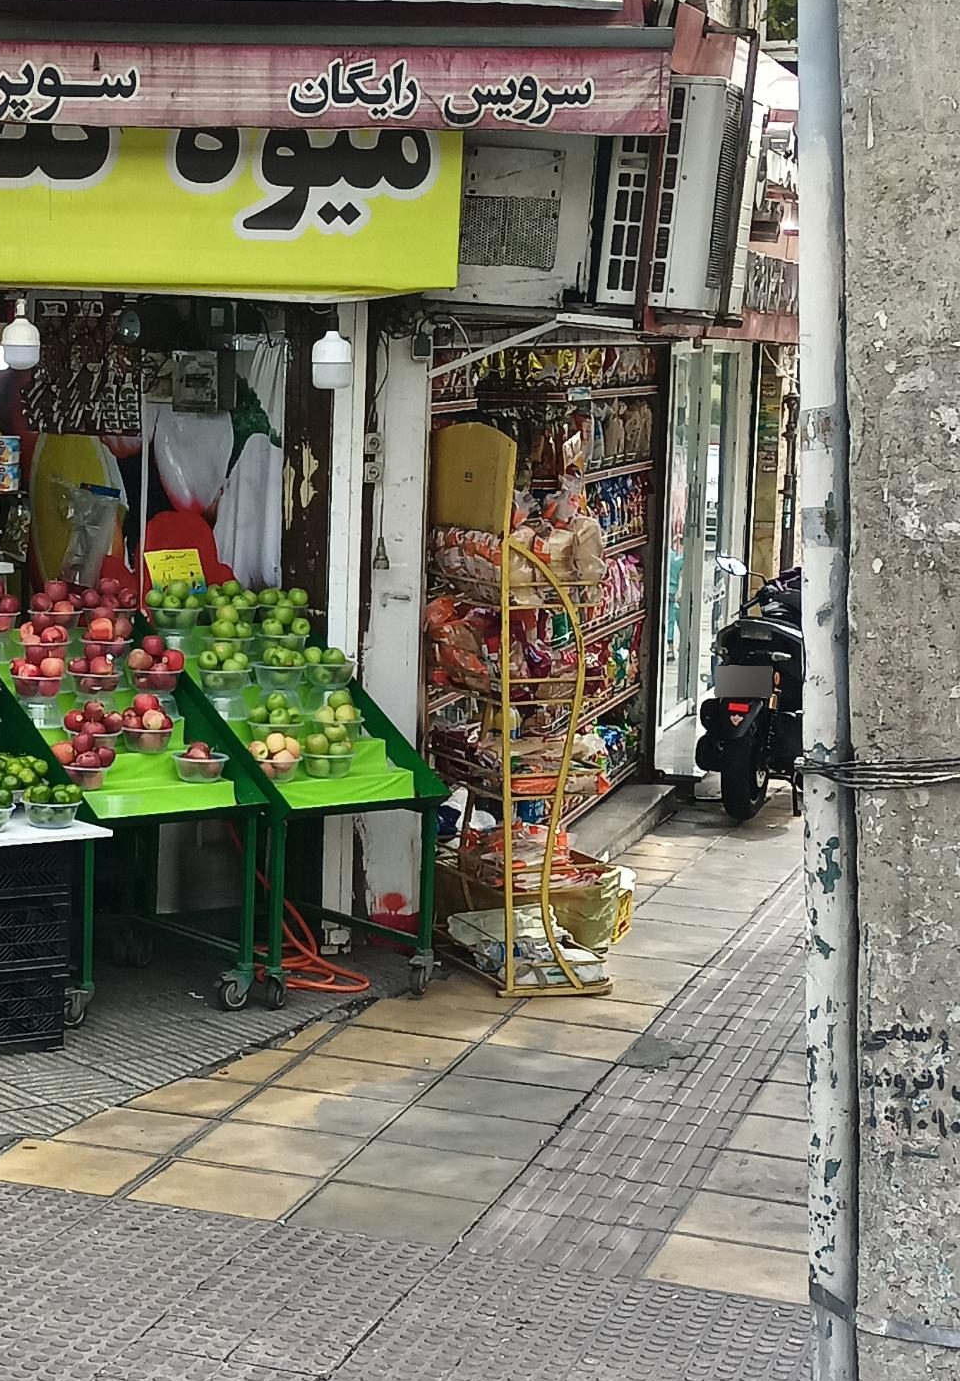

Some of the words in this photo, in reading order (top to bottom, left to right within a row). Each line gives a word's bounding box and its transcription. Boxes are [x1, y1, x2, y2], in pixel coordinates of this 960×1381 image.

[289, 59, 419, 118] رایگان
[442, 73, 593, 126] سرویس
[173, 128, 433, 232] میوه
